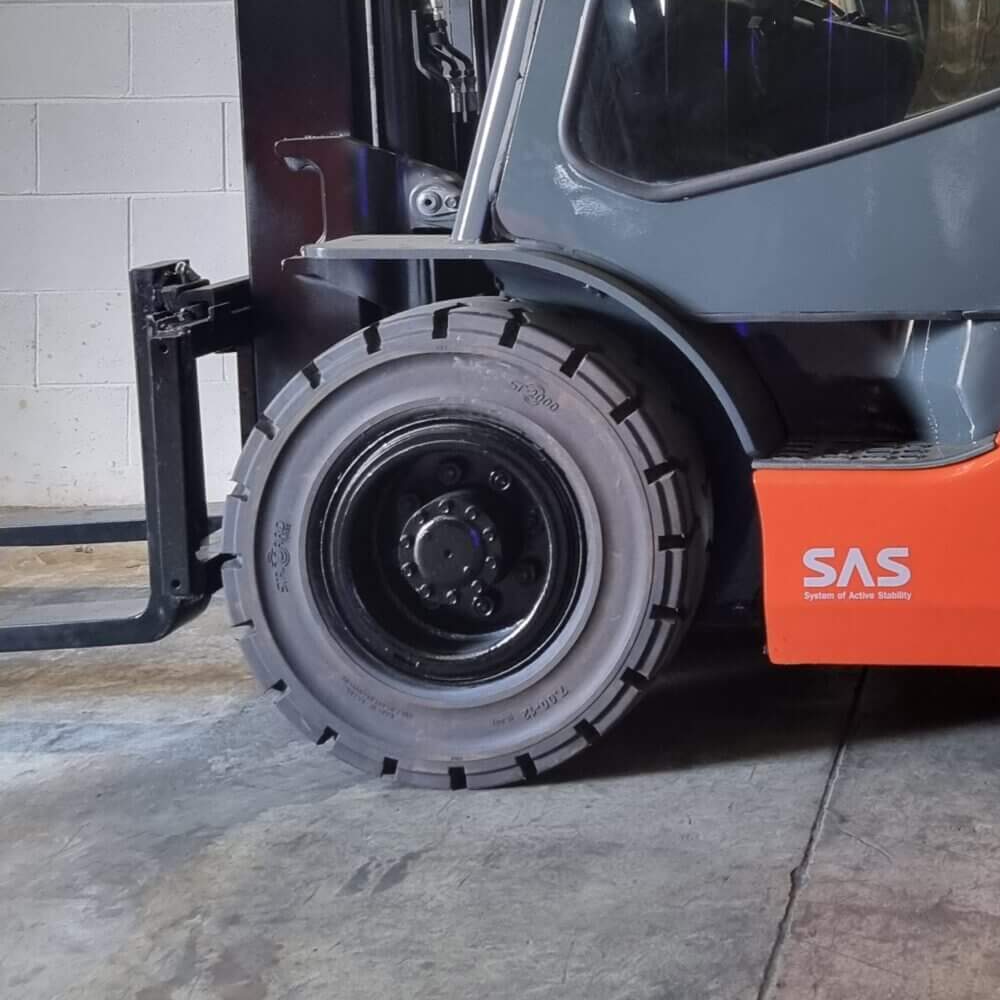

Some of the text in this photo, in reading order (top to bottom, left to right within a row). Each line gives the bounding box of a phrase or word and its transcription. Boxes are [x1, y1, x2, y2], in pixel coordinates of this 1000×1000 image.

[802, 546, 912, 588] SAS
[803, 591, 912, 602] System of Active Stability
